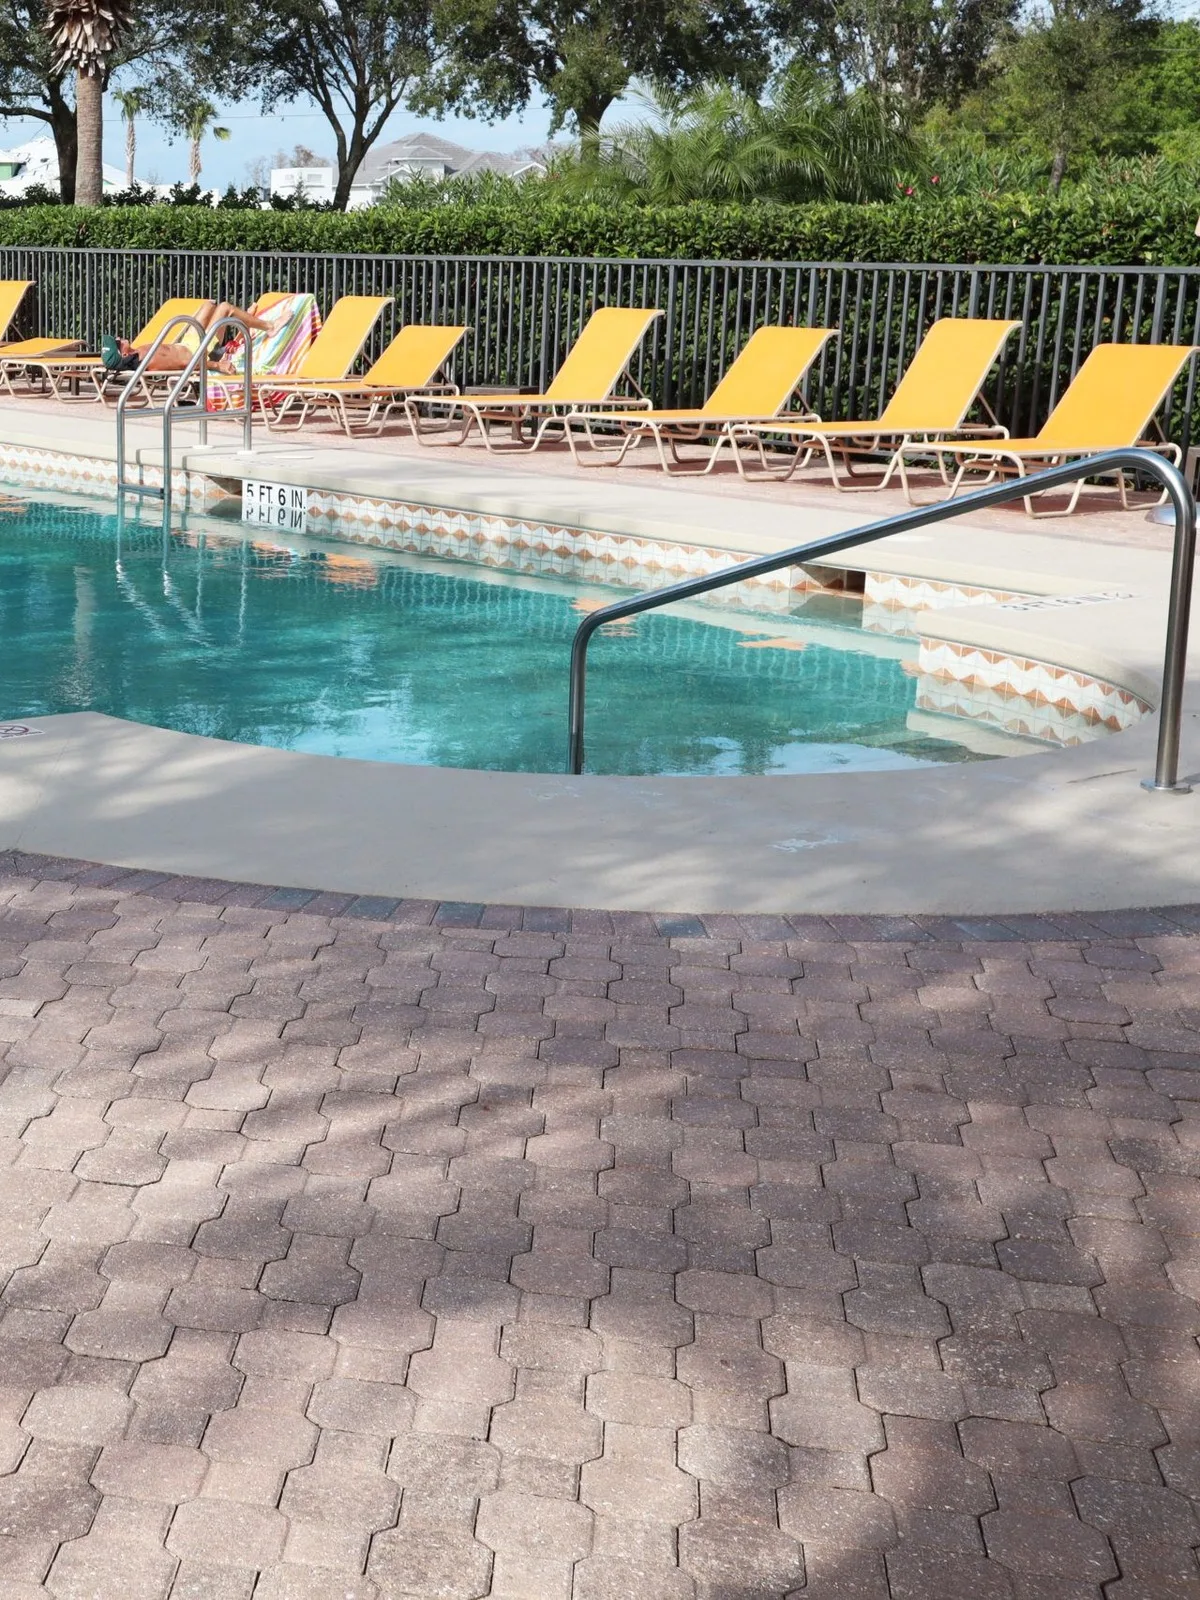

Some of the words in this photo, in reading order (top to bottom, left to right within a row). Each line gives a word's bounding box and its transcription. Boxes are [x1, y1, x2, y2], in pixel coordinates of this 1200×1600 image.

[246, 483, 254, 498] 5
[278, 488, 286, 506] 6
[291, 489, 306, 509] IN.
